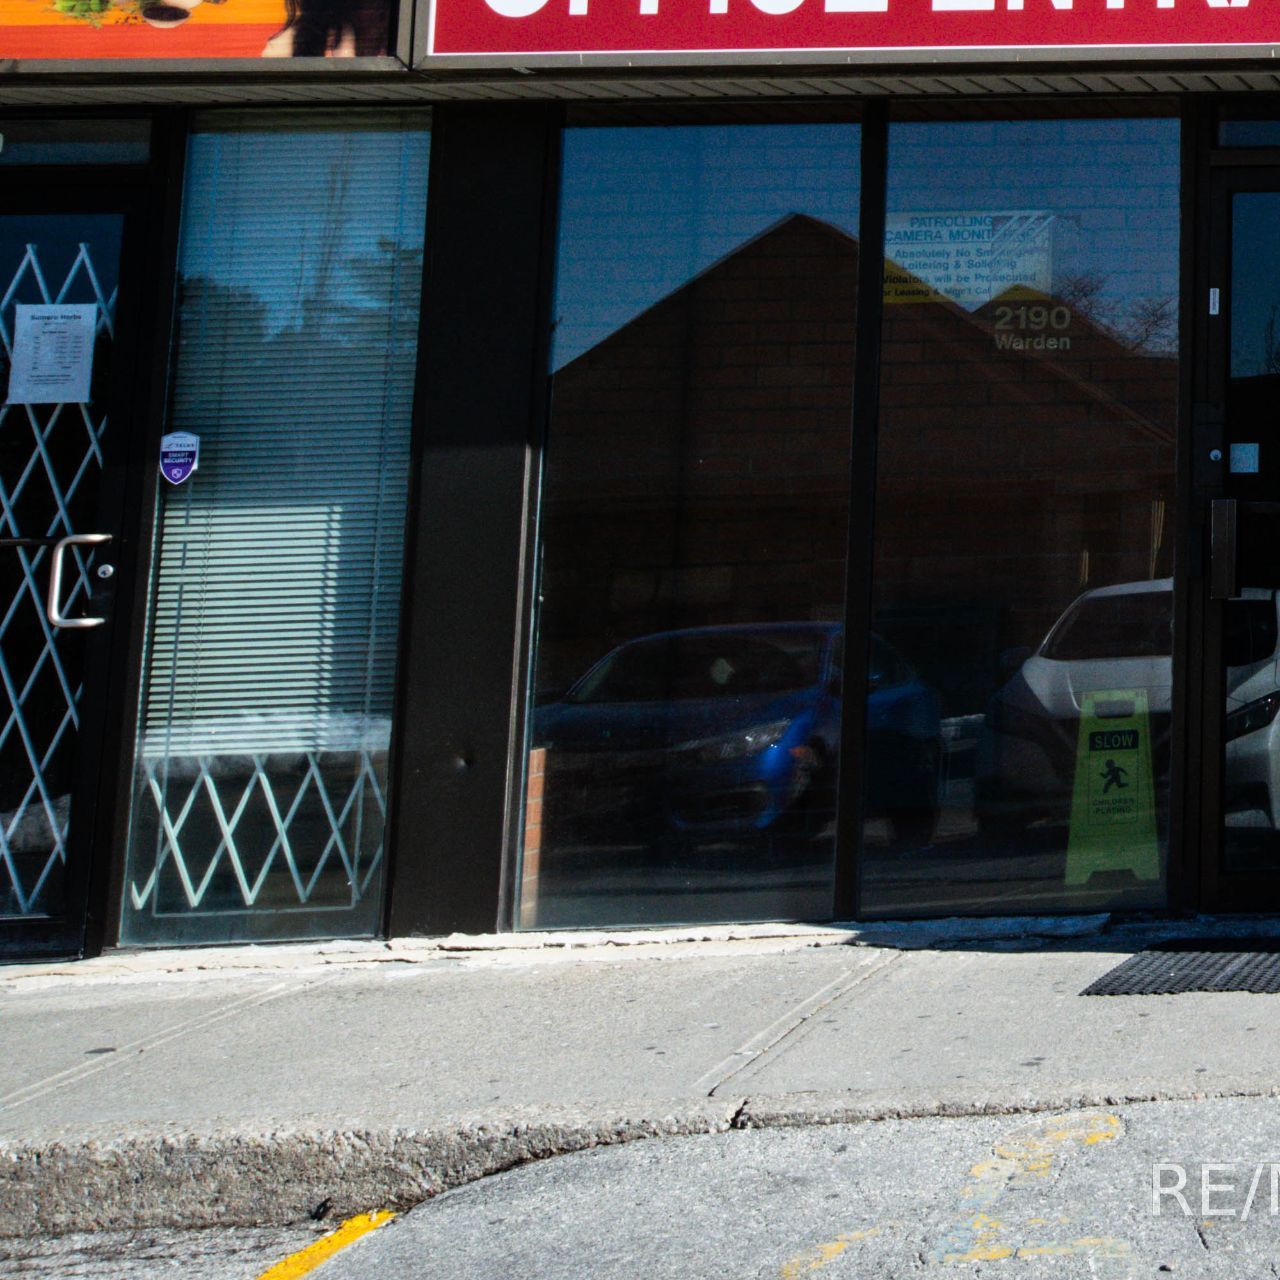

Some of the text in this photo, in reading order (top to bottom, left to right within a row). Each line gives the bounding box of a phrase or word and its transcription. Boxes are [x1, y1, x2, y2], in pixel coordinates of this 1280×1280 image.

[911, 216, 993, 228] PATROLLING
[885, 230, 942, 242] CAMERA
[895, 249, 951, 260] Absolutely
[956, 248, 971, 258] No
[903, 260, 949, 271] Loitering
[994, 306, 1071, 330] 2190
[994, 334, 1071, 350] Warden
[1095, 735, 1133, 748] SLOW
